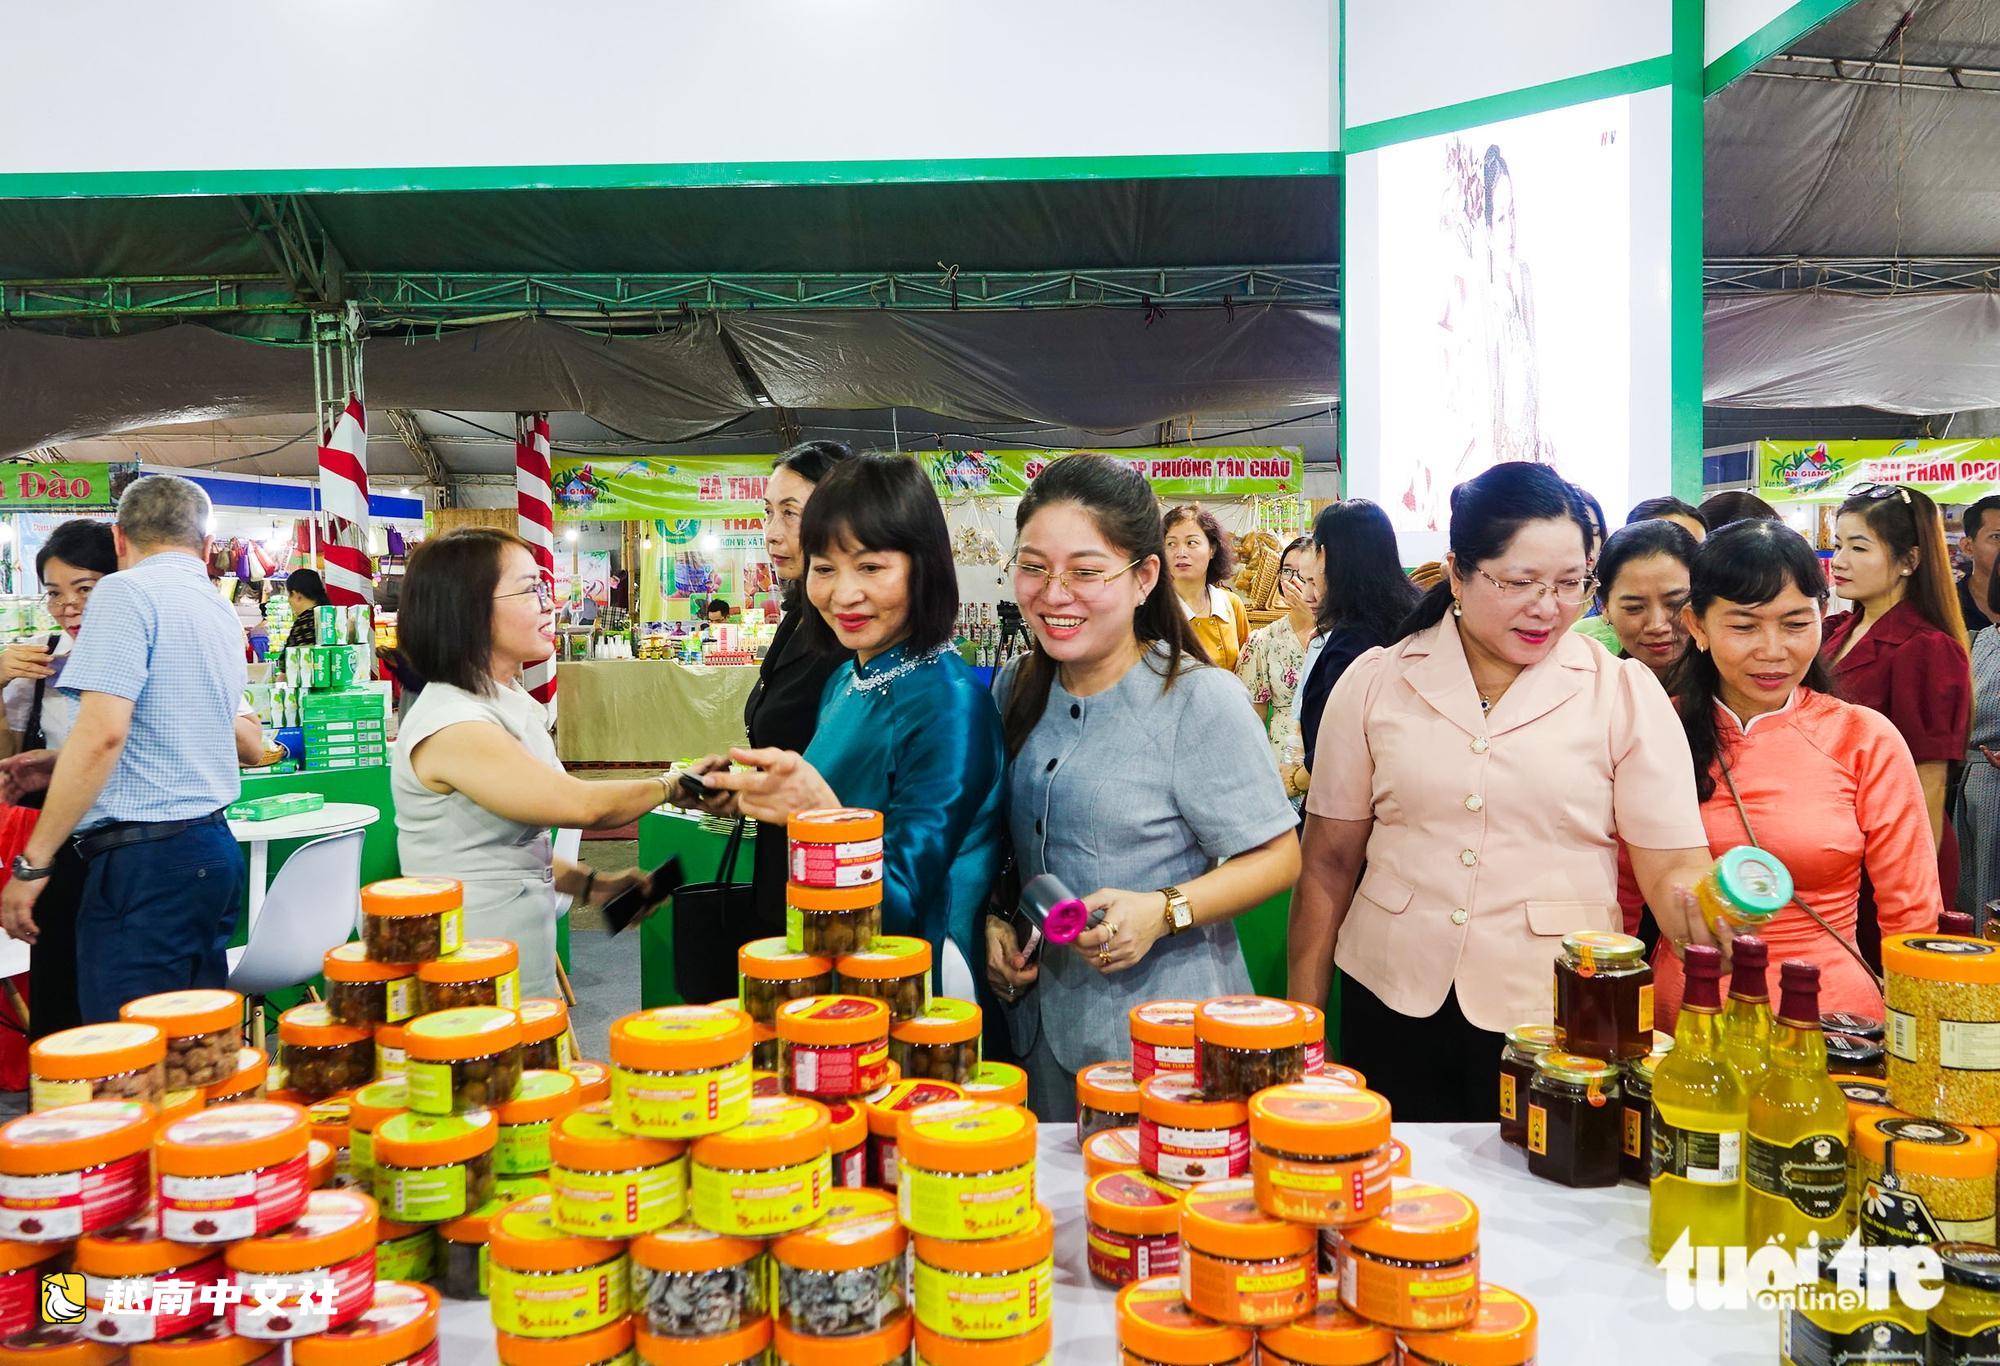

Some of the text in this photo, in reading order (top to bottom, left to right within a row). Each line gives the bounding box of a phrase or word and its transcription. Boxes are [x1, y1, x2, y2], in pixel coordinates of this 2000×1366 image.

[1151, 458, 1213, 478] PHƯỜNG
[1216, 457, 1246, 478] TÂN
[1249, 457, 1291, 478] CHÂU
[1961, 462, 2000, 481] OCO
[17, 469, 92, 499] Đào
